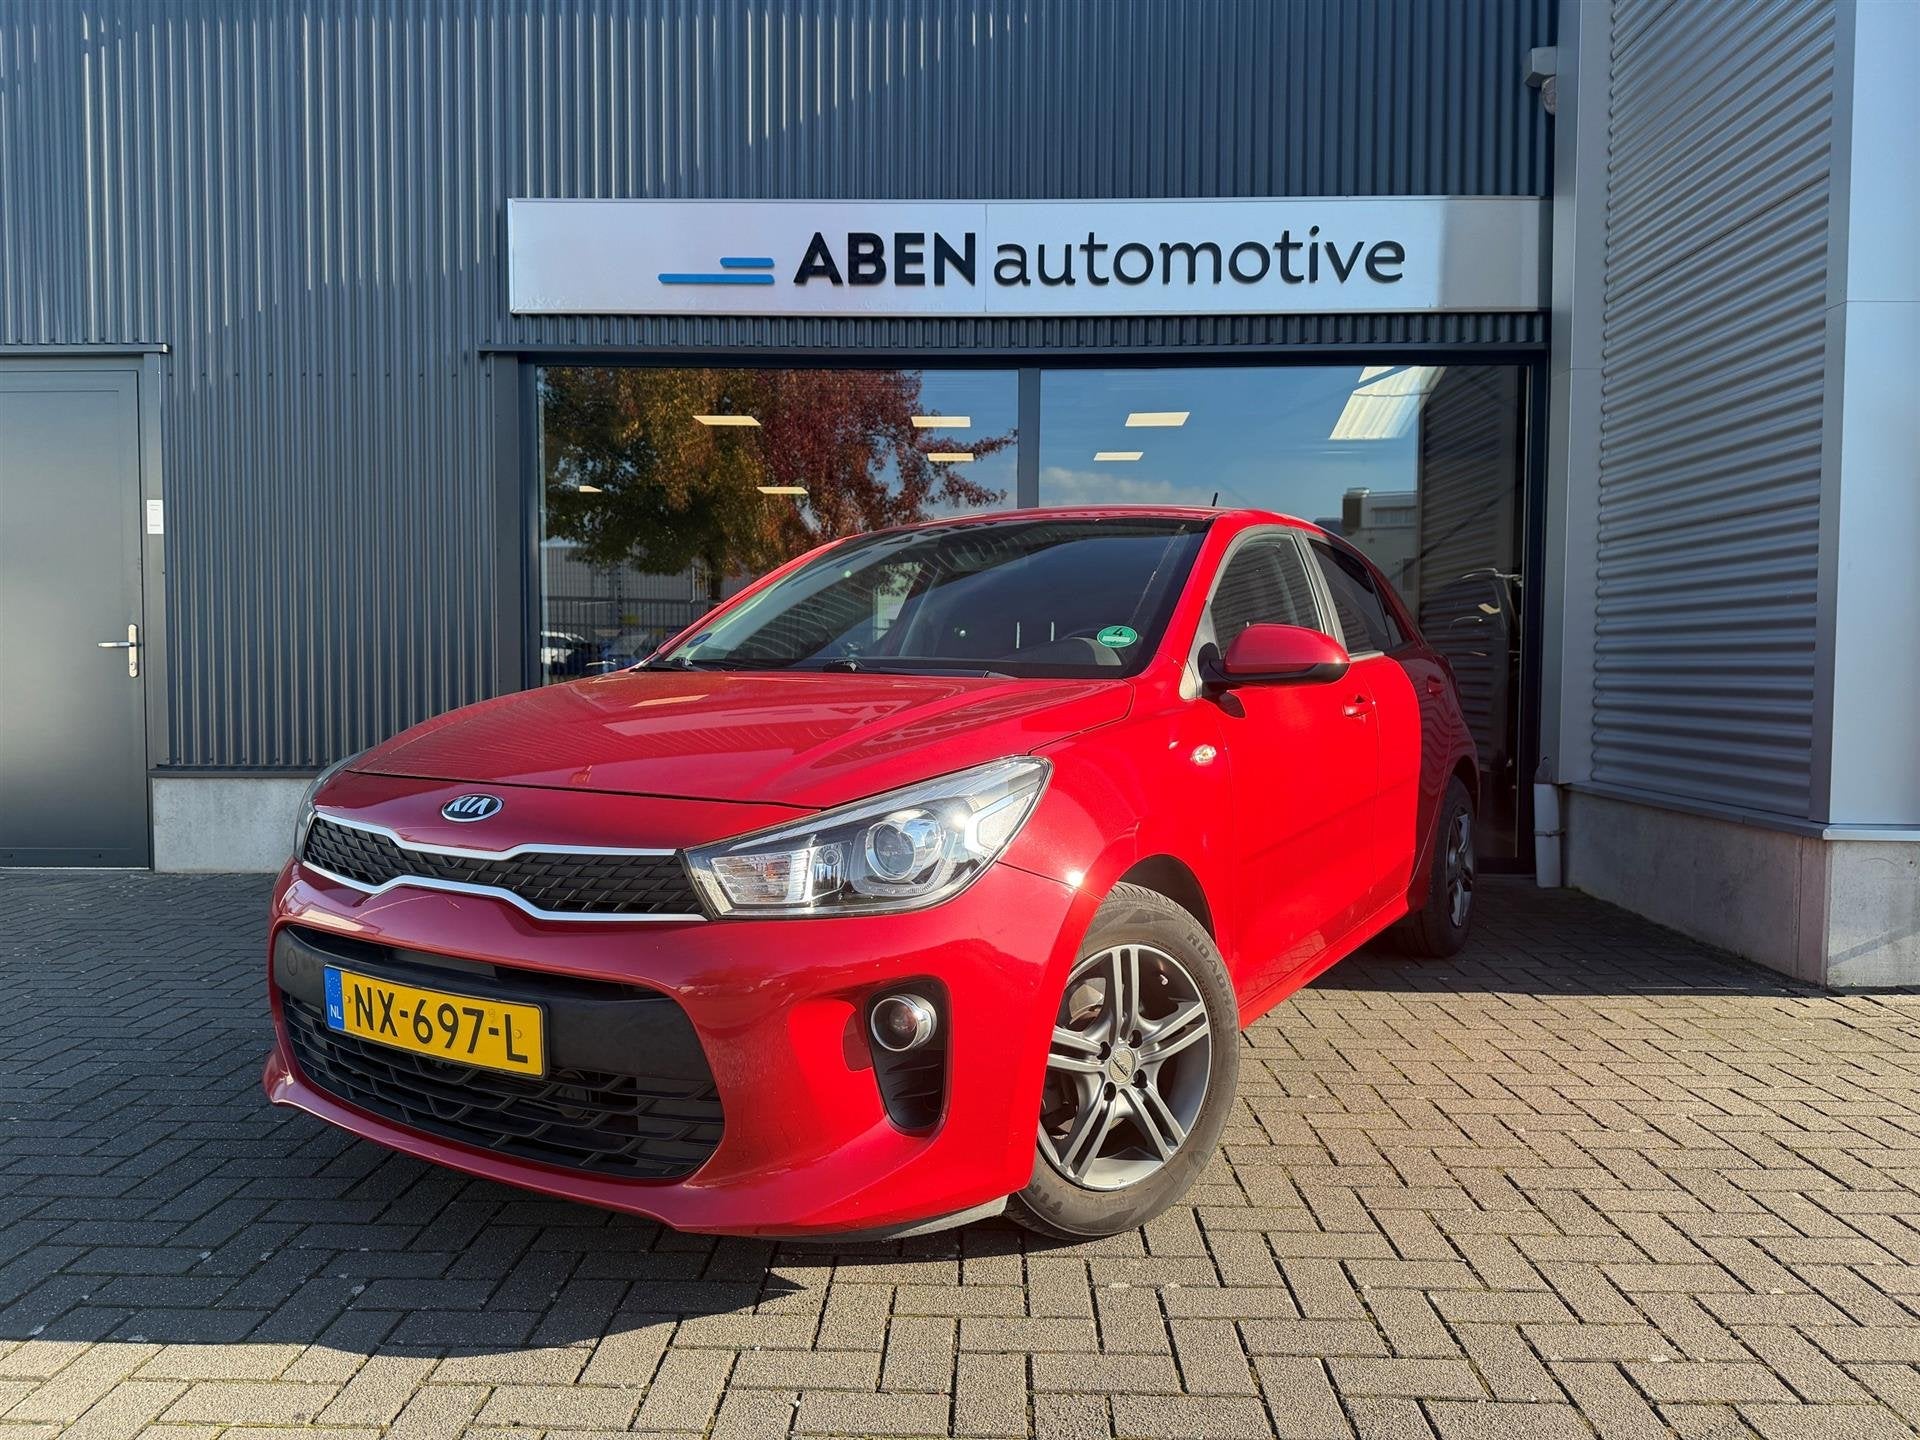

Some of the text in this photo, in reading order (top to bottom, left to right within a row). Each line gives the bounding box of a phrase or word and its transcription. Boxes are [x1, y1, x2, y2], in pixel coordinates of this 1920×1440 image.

[794, 225, 1405, 287] ABEN automotive
[446, 796, 491, 815] KIA
[329, 1003, 343, 1021] NL
[354, 983, 529, 1064] NX-697-L
